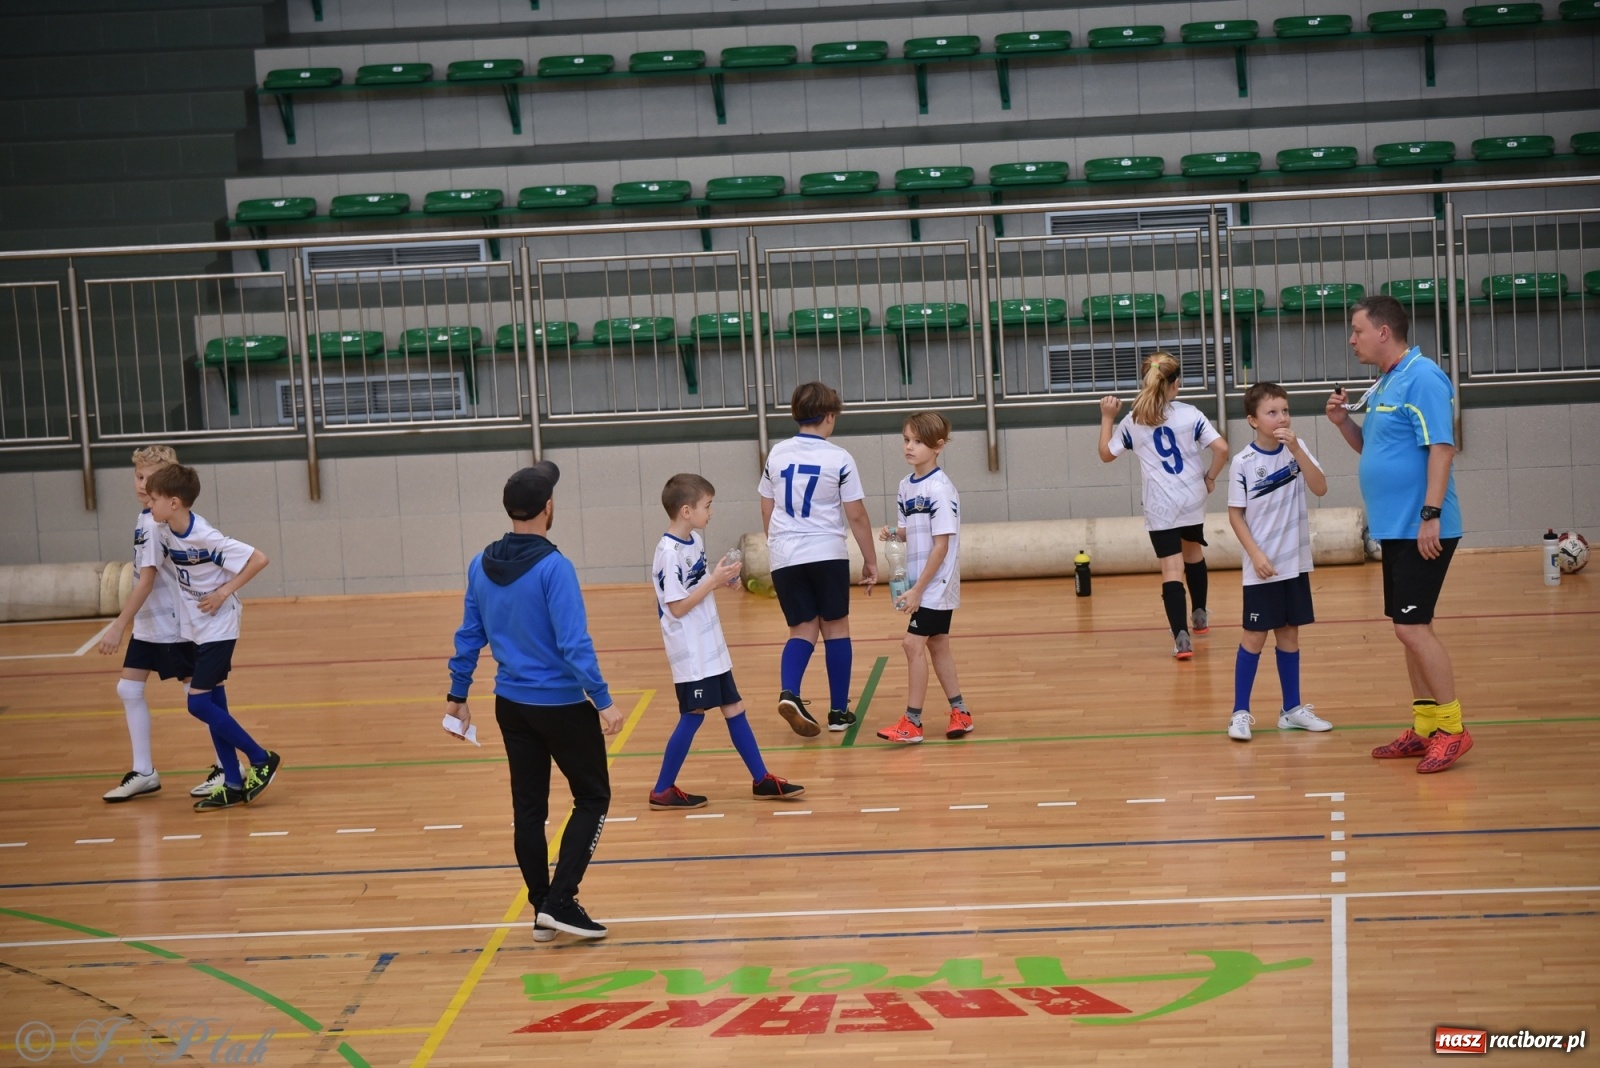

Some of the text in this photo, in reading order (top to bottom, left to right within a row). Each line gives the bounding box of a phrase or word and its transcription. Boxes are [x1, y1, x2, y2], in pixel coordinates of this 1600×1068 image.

[1153, 426, 1185, 475] 9
[780, 464, 822, 518] 17
[519, 950, 1314, 1025] Arena
